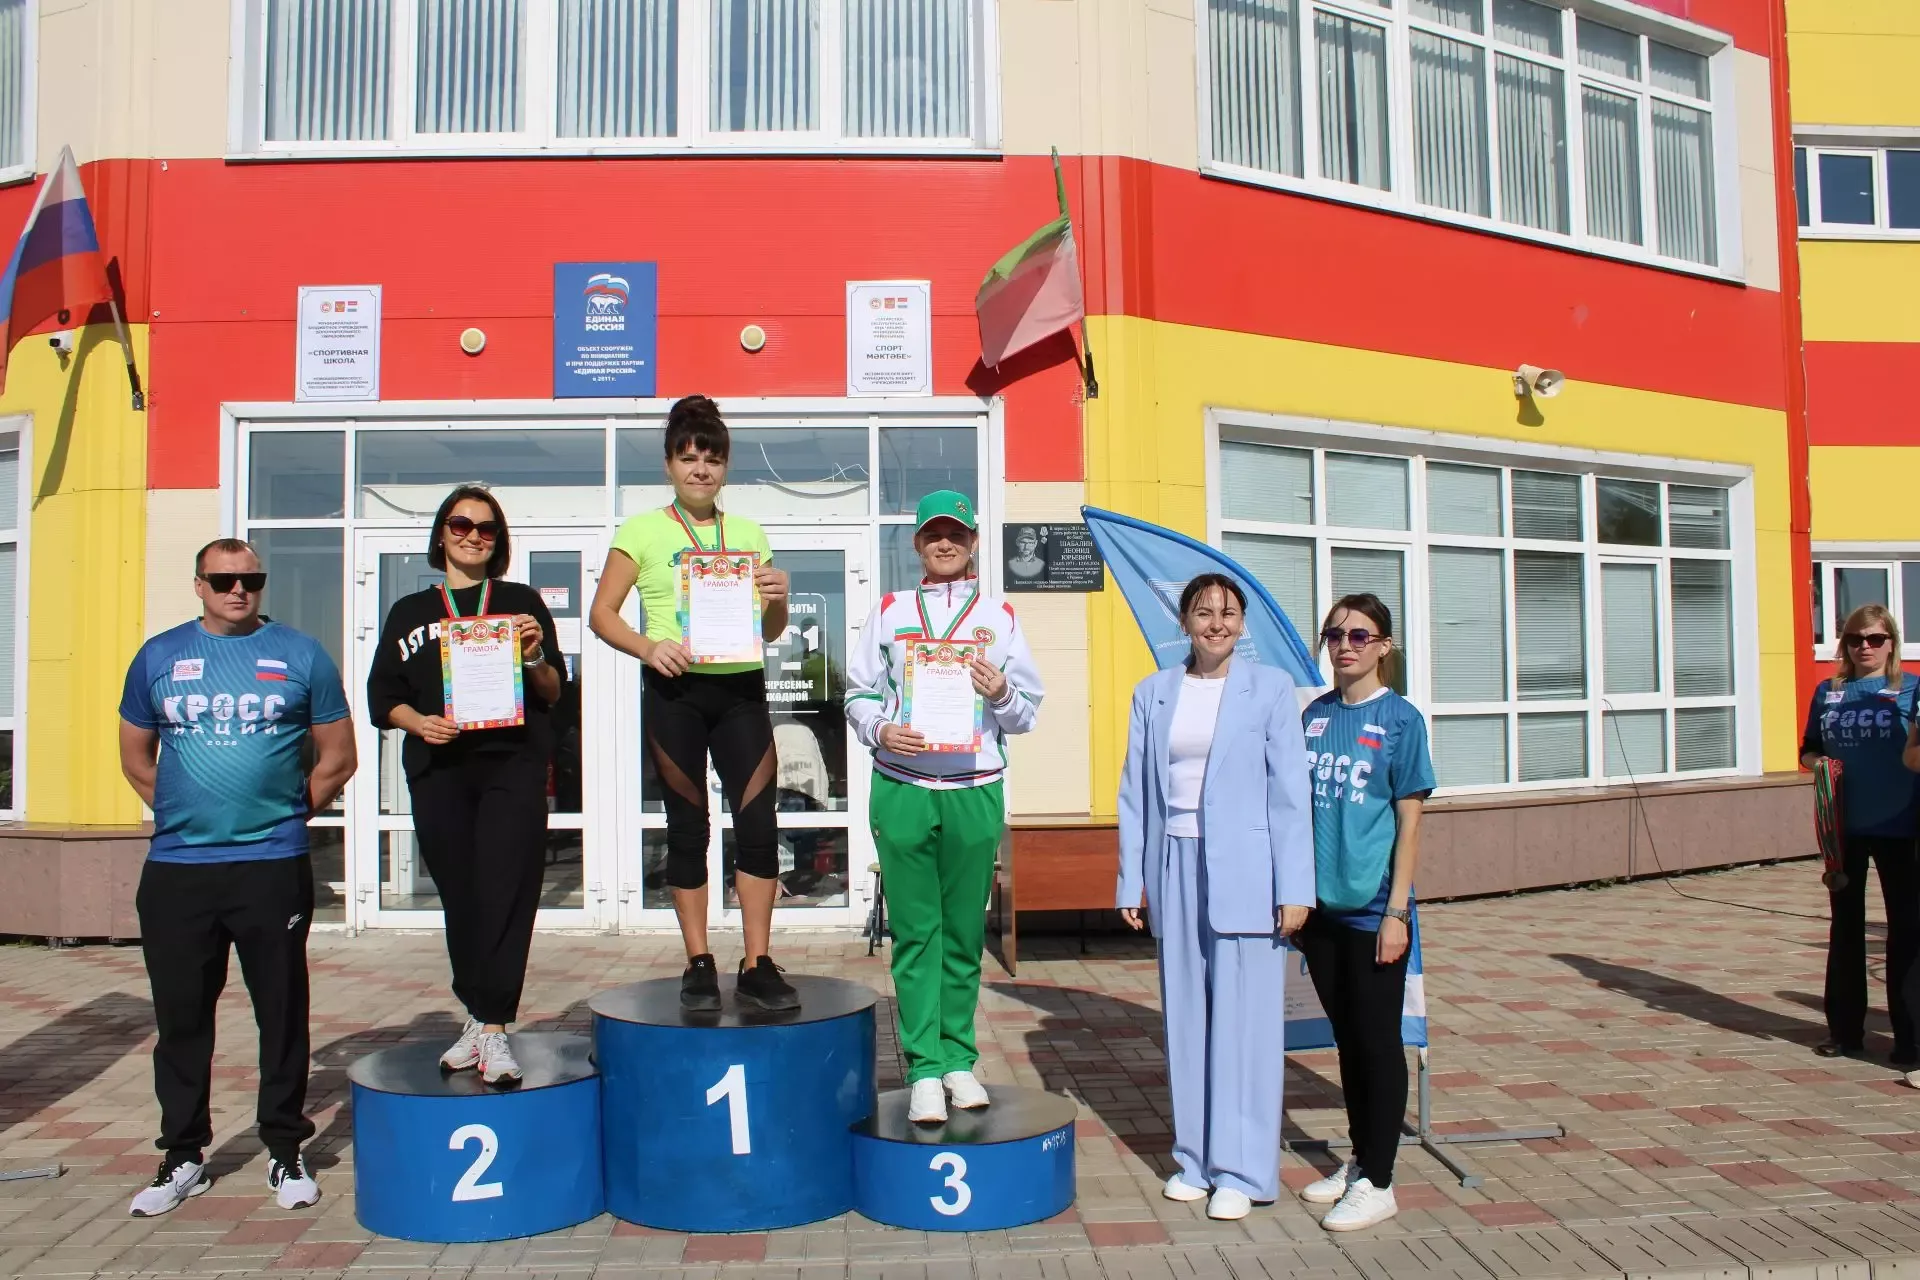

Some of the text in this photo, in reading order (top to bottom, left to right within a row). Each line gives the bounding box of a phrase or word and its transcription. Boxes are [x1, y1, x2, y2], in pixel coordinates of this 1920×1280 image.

[585, 315, 625, 323] ЕДИНАЯ
[585, 323, 625, 332] РОССИЯ
[703, 580, 739, 588] ГРАМОТА
[787, 603, 817, 614] БОТЫ
[463, 645, 499, 653] ГРАМОТА
[926, 668, 963, 676] ГРАМОТА
[765, 680, 814, 690] КРЕСЕНЬЕ
[766, 691, 809, 702] ХОДНОЙ
[163, 693, 286, 722] КРОСС
[1822, 728, 1891, 740] АЦИИ
[1306, 750, 1372, 788] РОСС
[1315, 782, 1365, 805] ЦИИ
[706, 1064, 751, 1154] 1
[449, 1124, 504, 1201] 2
[929, 1151, 972, 1216] 3
